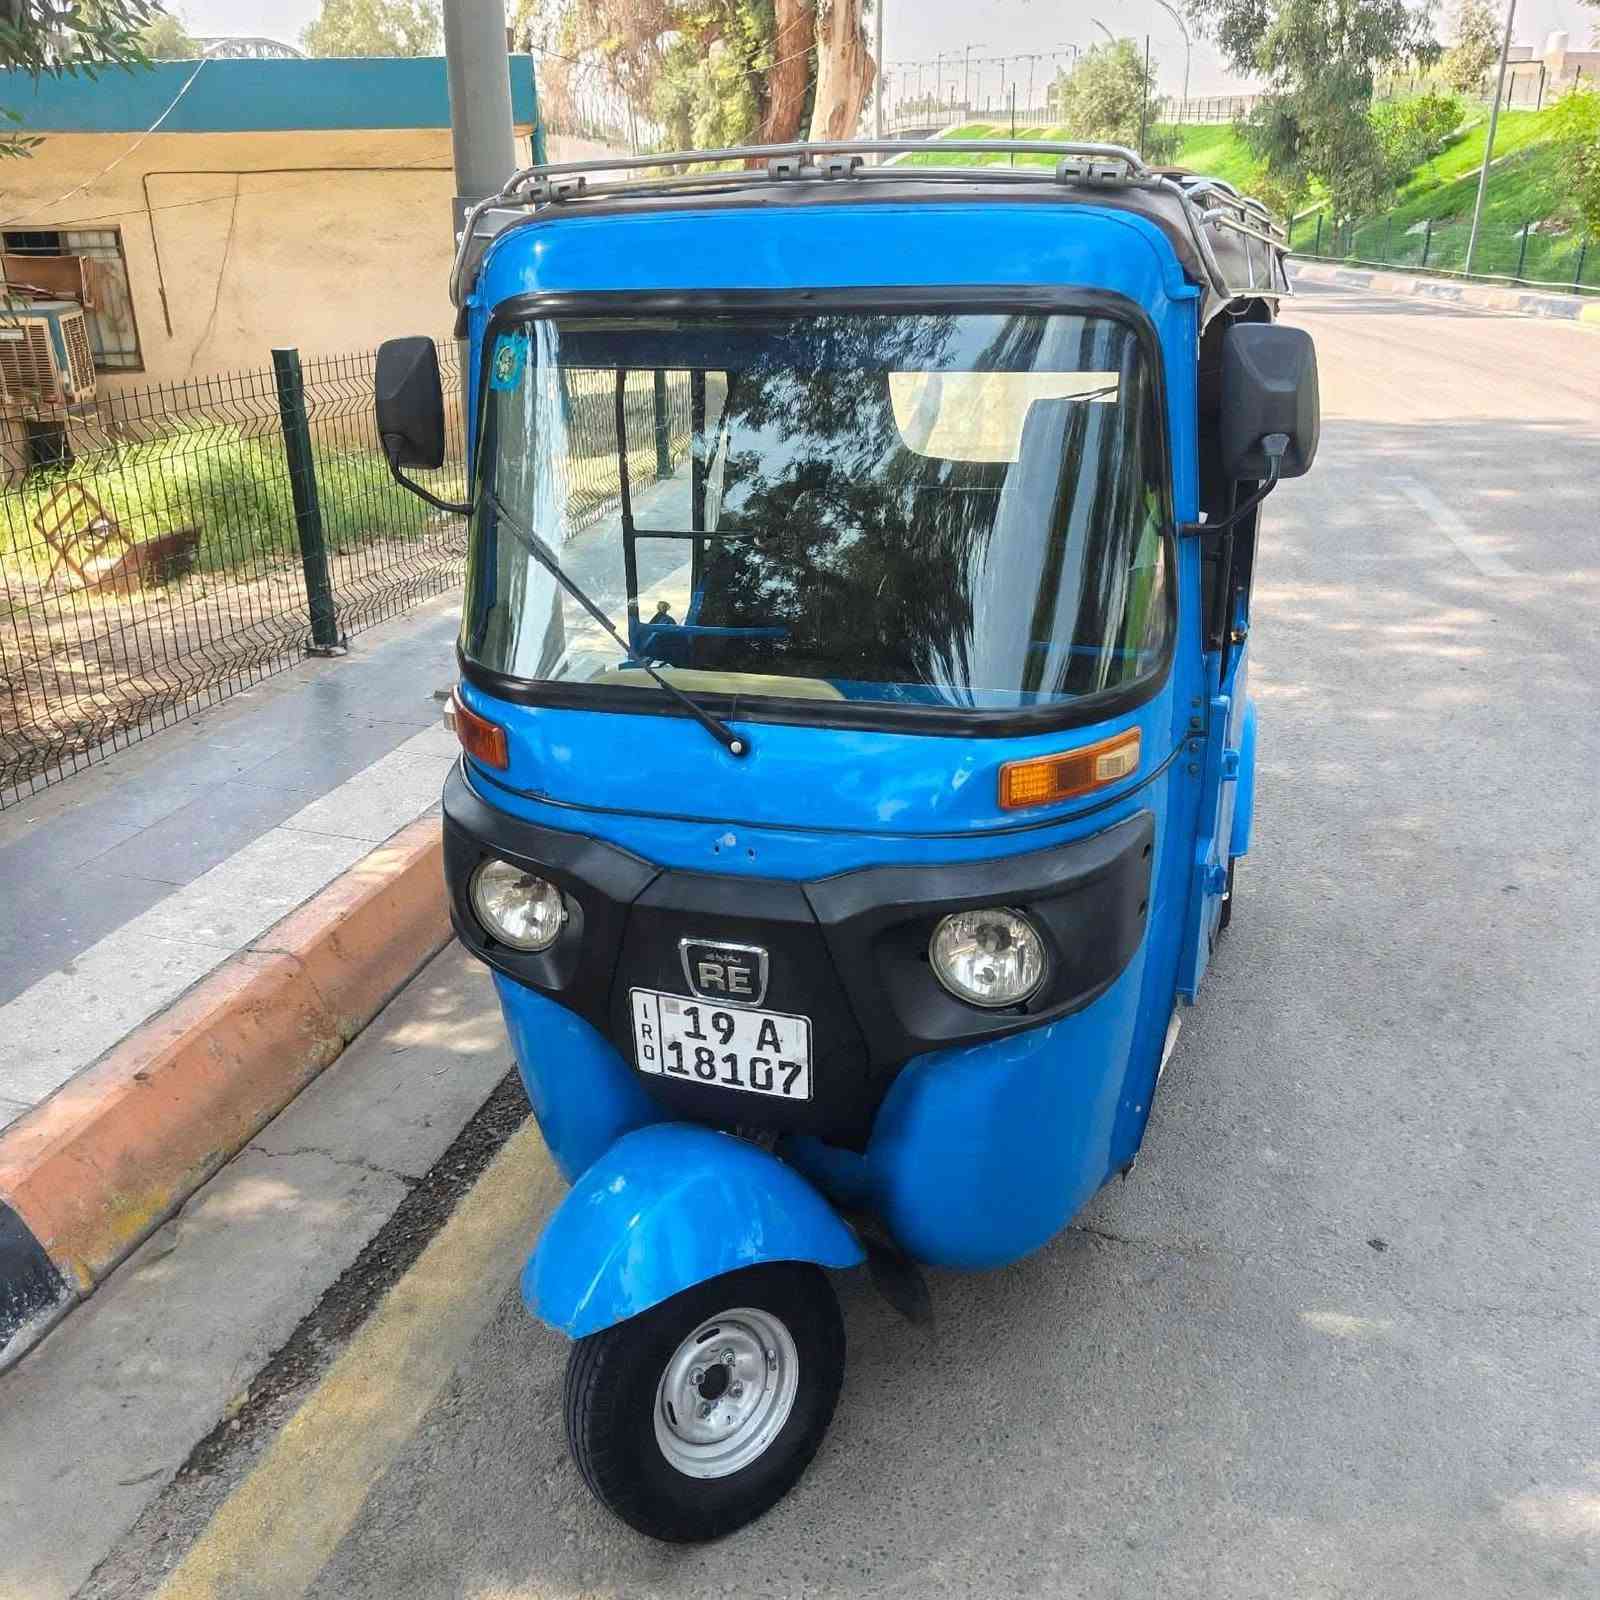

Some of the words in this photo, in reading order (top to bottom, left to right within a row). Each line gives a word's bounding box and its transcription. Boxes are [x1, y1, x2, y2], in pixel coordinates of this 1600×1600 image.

[698, 962, 752, 993] RE
[683, 1006, 735, 1045] 19
[756, 1018, 782, 1053] A
[667, 1041, 802, 1095] 18107
